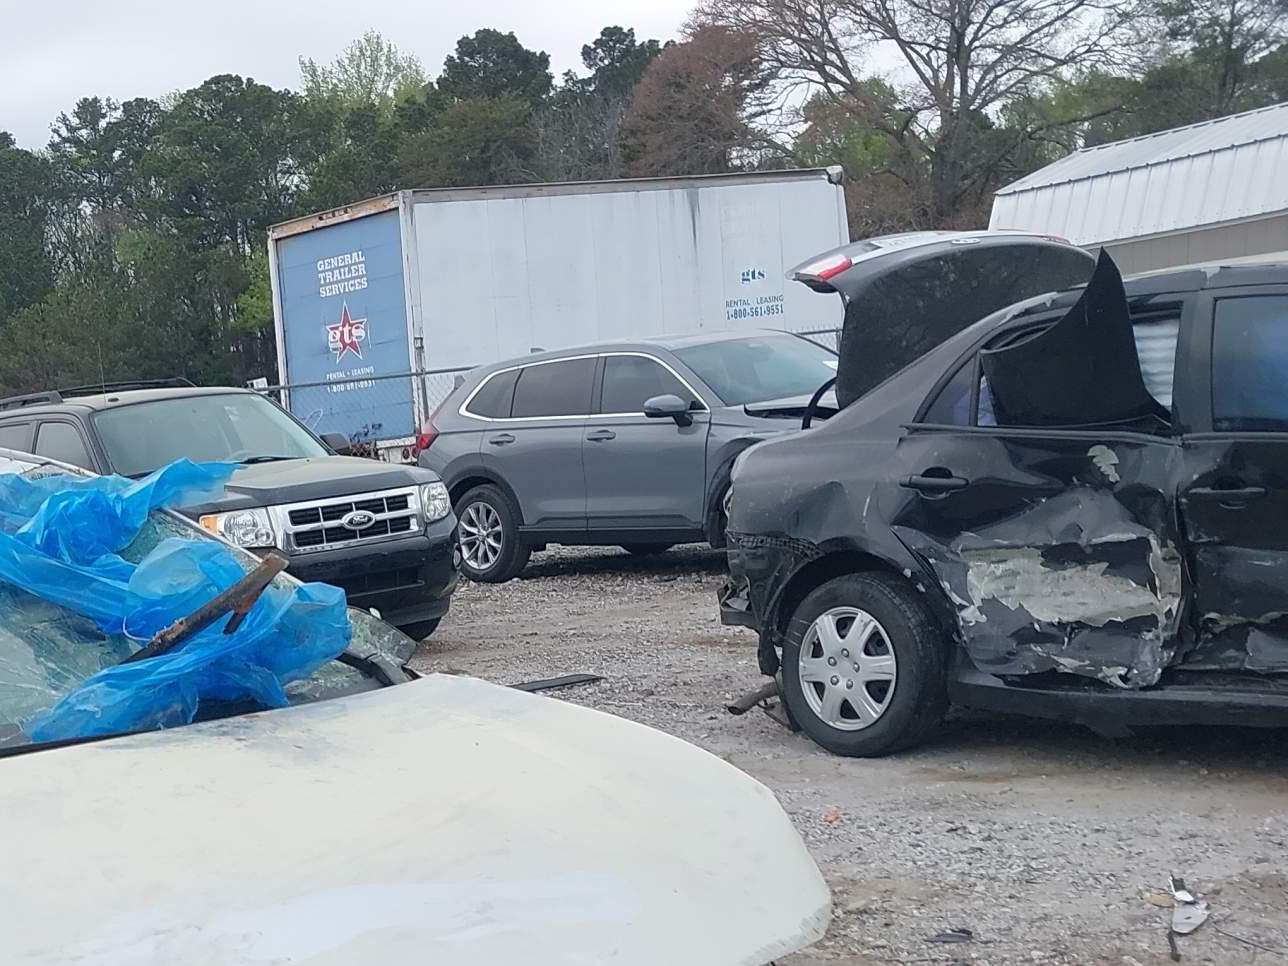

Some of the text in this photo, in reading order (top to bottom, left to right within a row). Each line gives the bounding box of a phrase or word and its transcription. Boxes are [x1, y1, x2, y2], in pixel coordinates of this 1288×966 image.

[317, 251, 366, 271] GENERAL
[318, 263, 367, 285] TRAILER
[741, 267, 766, 285] gts
[319, 277, 368, 298] SERVICES
[725, 295, 784, 308] RENTAL LEASING
[328, 323, 367, 354] gts
